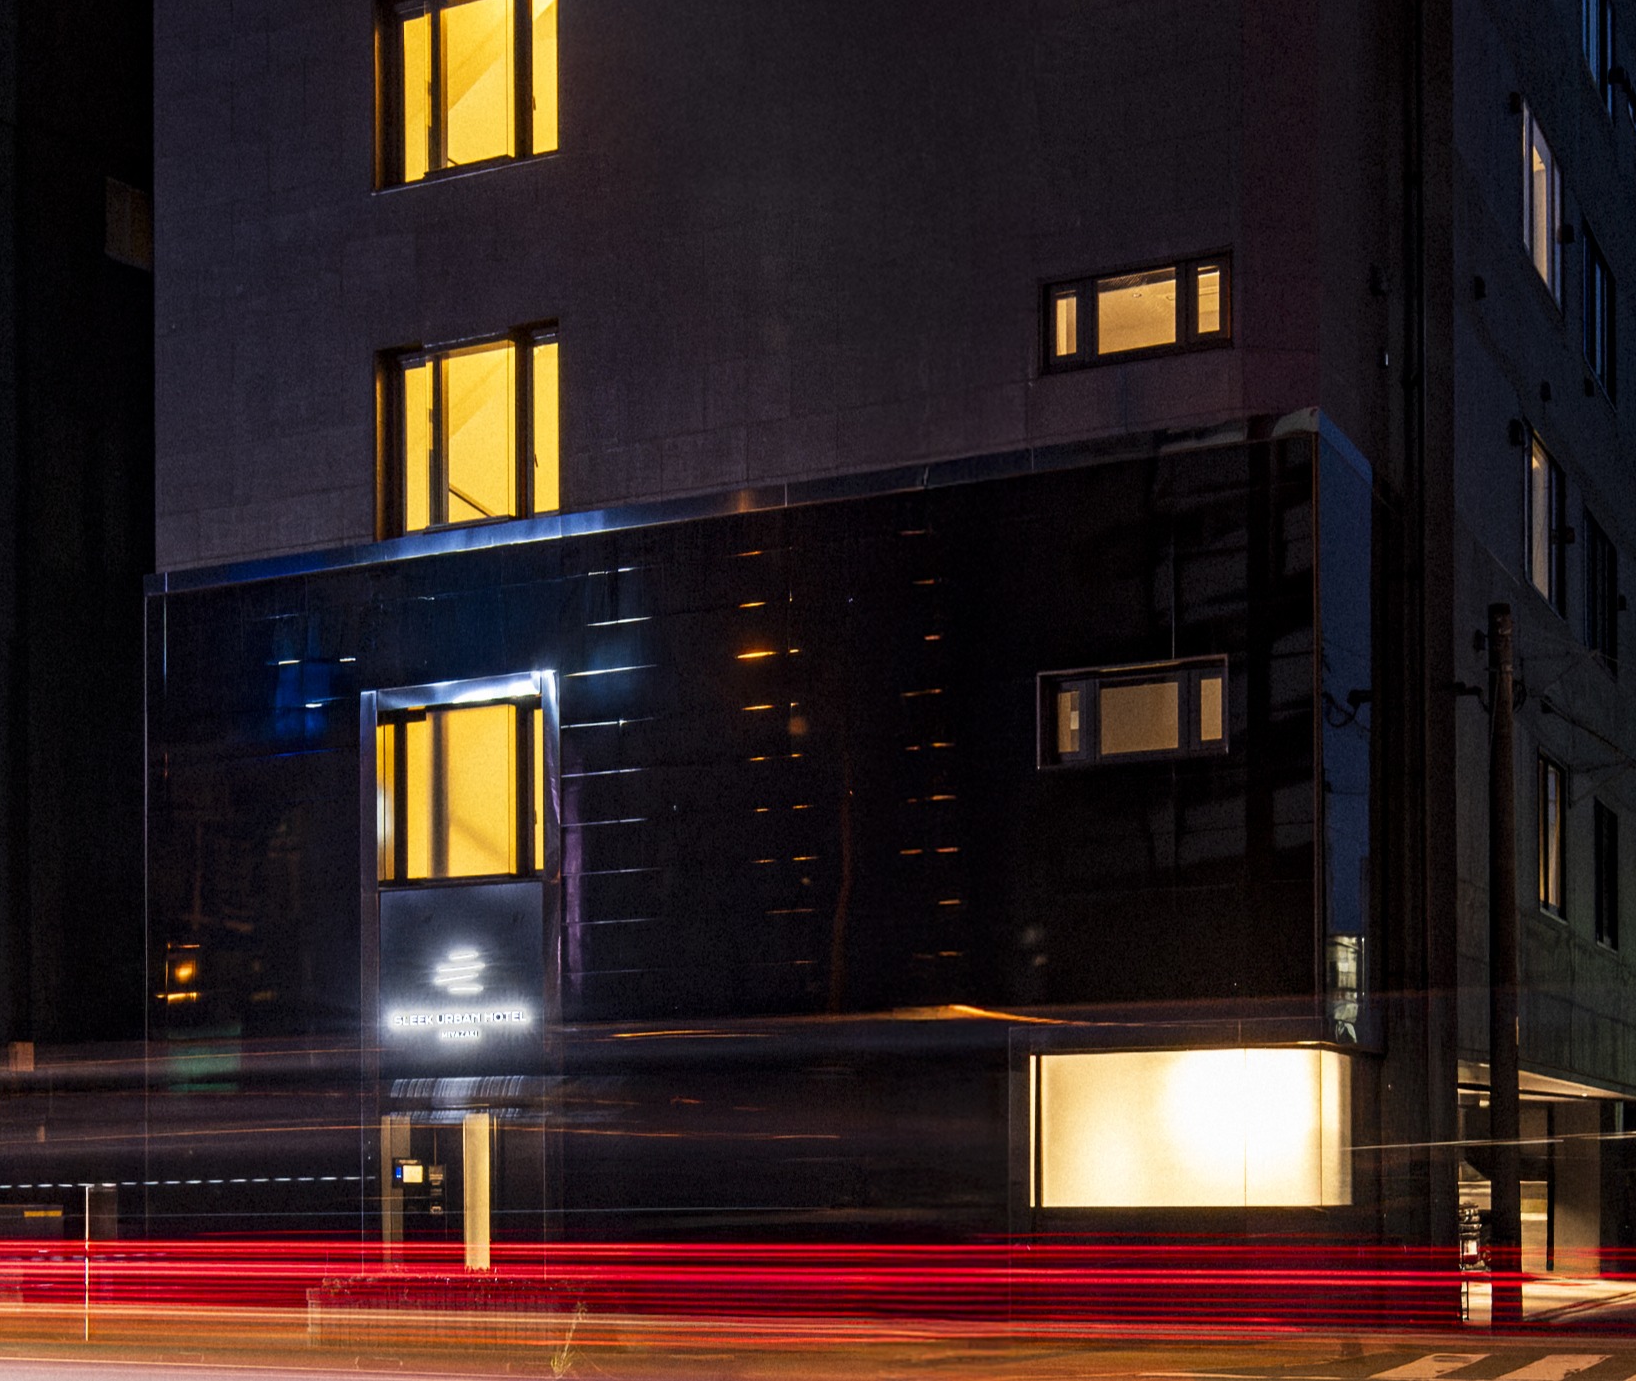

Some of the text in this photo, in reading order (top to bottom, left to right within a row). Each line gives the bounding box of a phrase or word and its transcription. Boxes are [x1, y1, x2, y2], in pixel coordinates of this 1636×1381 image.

[393, 1011, 526, 1026] SLEEK URBAN HOTEL
[441, 1030, 479, 1039] MIYAZAKI
